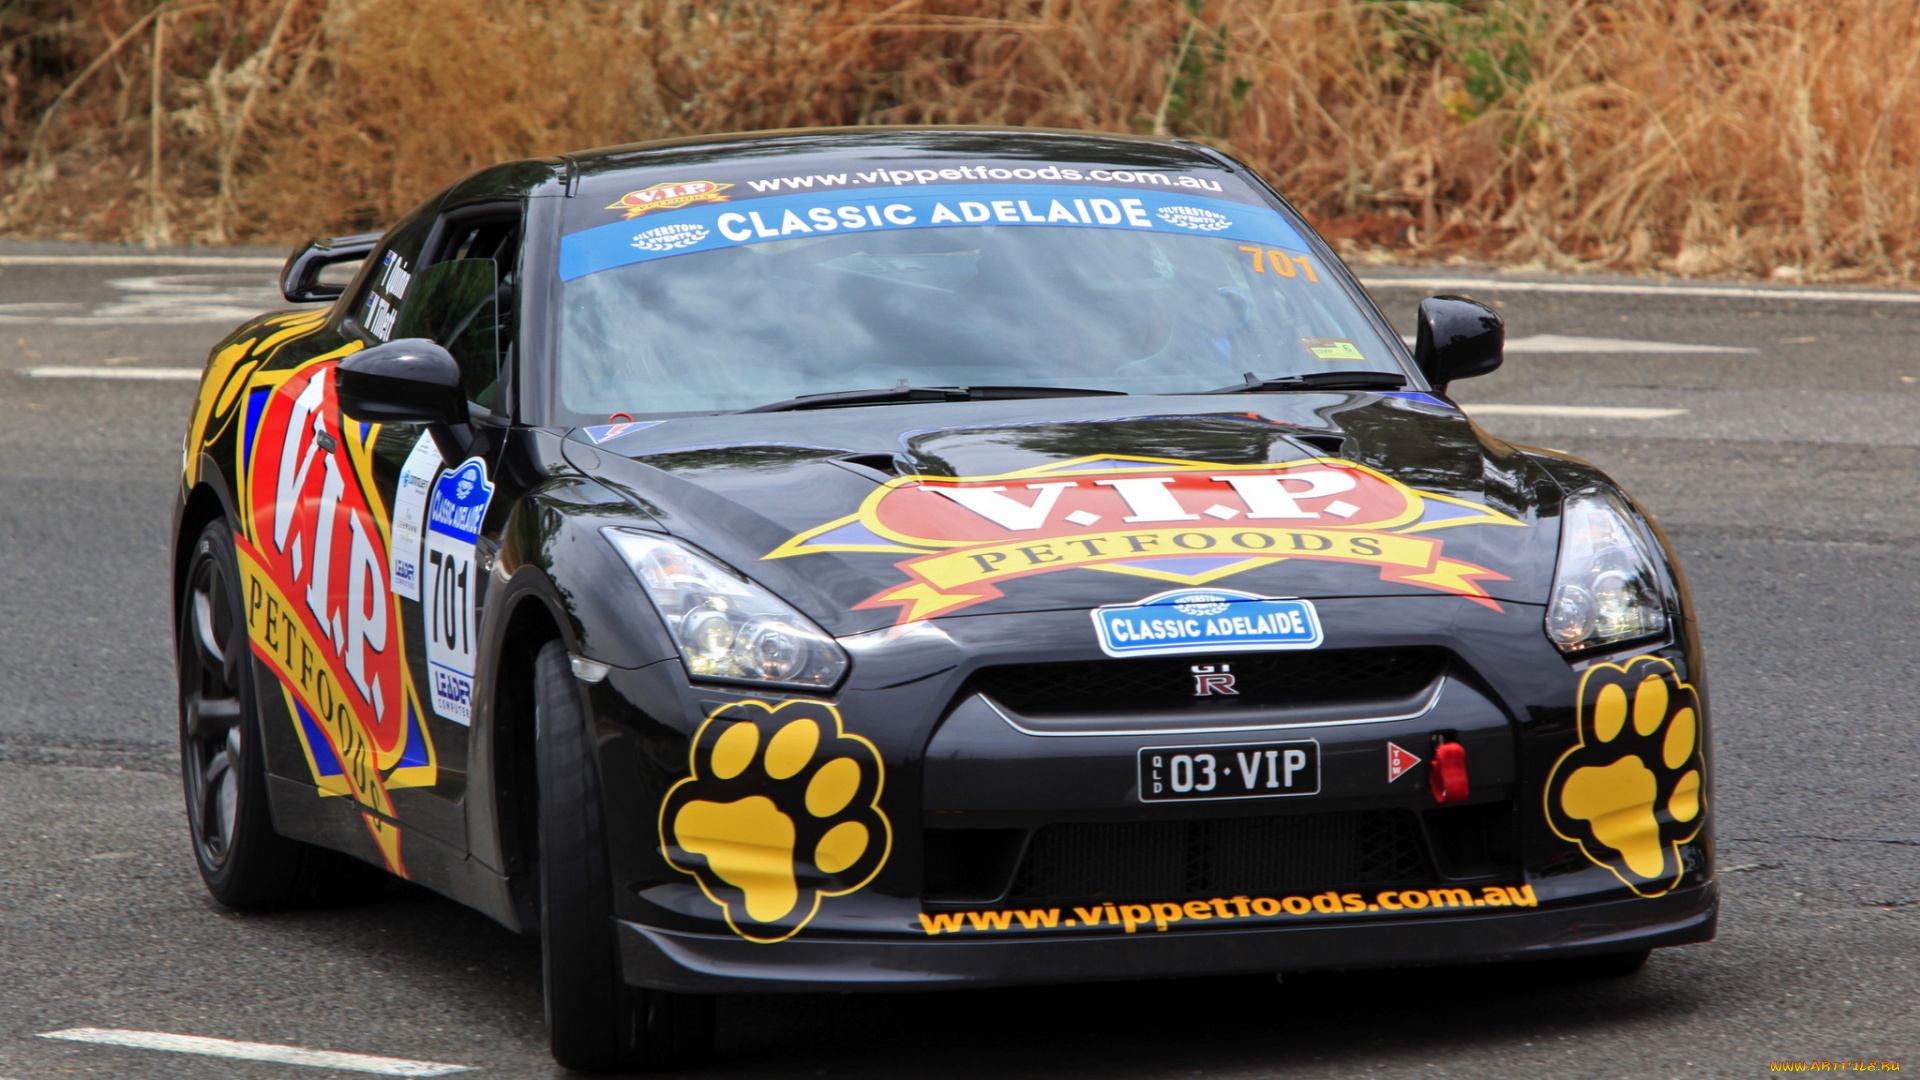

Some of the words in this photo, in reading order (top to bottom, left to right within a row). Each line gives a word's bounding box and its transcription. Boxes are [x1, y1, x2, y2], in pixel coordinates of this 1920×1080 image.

[747, 165, 1223, 193] www.vippetfoods.com.au
[632, 223, 704, 241] SILVERSTONE
[717, 204, 917, 242] CLASSIC
[930, 198, 1153, 228] ADELAIDE
[1239, 245, 1318, 283] 701
[432, 489, 456, 526] CLASSIC
[452, 503, 485, 535] ADELAIDE
[919, 470, 1361, 531] V.I.P.
[273, 366, 386, 724] V.I.P.
[966, 531, 1383, 574] PETFOODS
[429, 548, 469, 656] 701
[1111, 618, 1201, 642] CLASSIC
[1205, 610, 1306, 636] ADELAIDE
[248, 573, 383, 832] PETFOODS
[434, 670, 472, 707] LEADER
[1152, 755, 1163, 794] QLD
[1392, 750, 1402, 775] TOW
[918, 884, 1539, 935] www.vippetfoods.com.au
